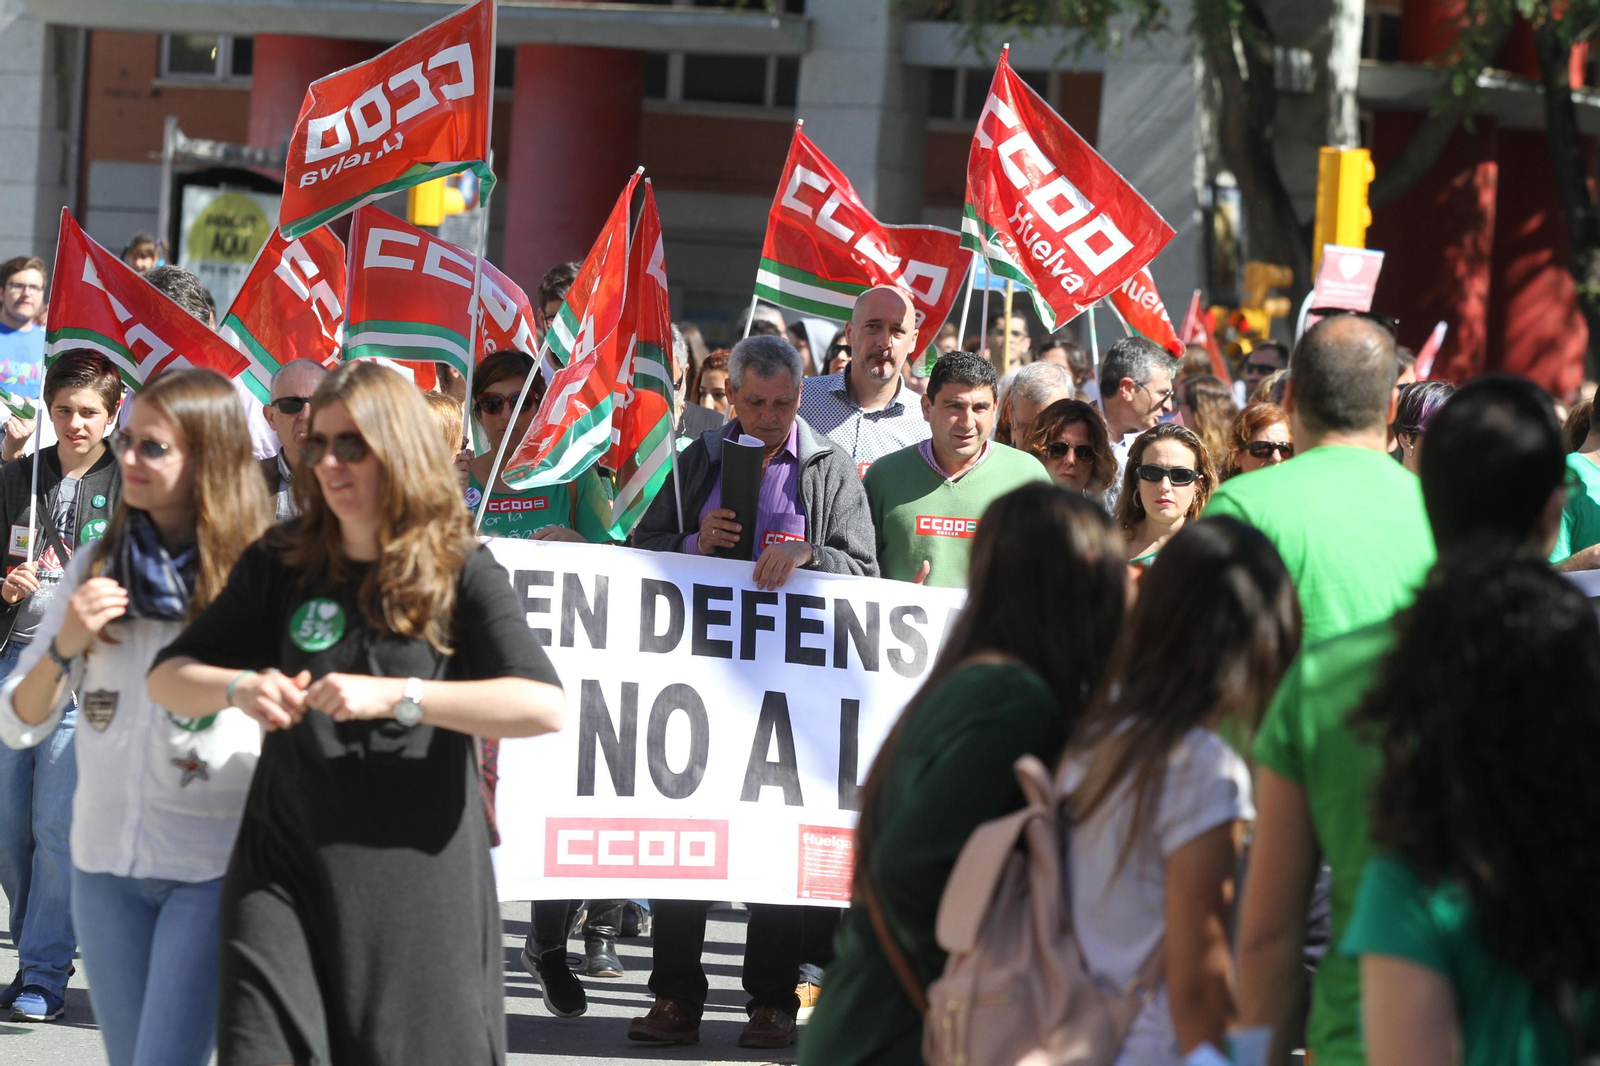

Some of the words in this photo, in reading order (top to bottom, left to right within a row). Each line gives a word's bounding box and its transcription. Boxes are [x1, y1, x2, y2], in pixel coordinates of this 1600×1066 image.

[974, 92, 1135, 277] CCOO
[1008, 201, 1085, 295] Huelva
[513, 569, 609, 650] EN
[576, 678, 710, 800] NO
[739, 689, 805, 808] A
[556, 829, 717, 868] CCOO
[803, 832, 852, 851] Huelga
